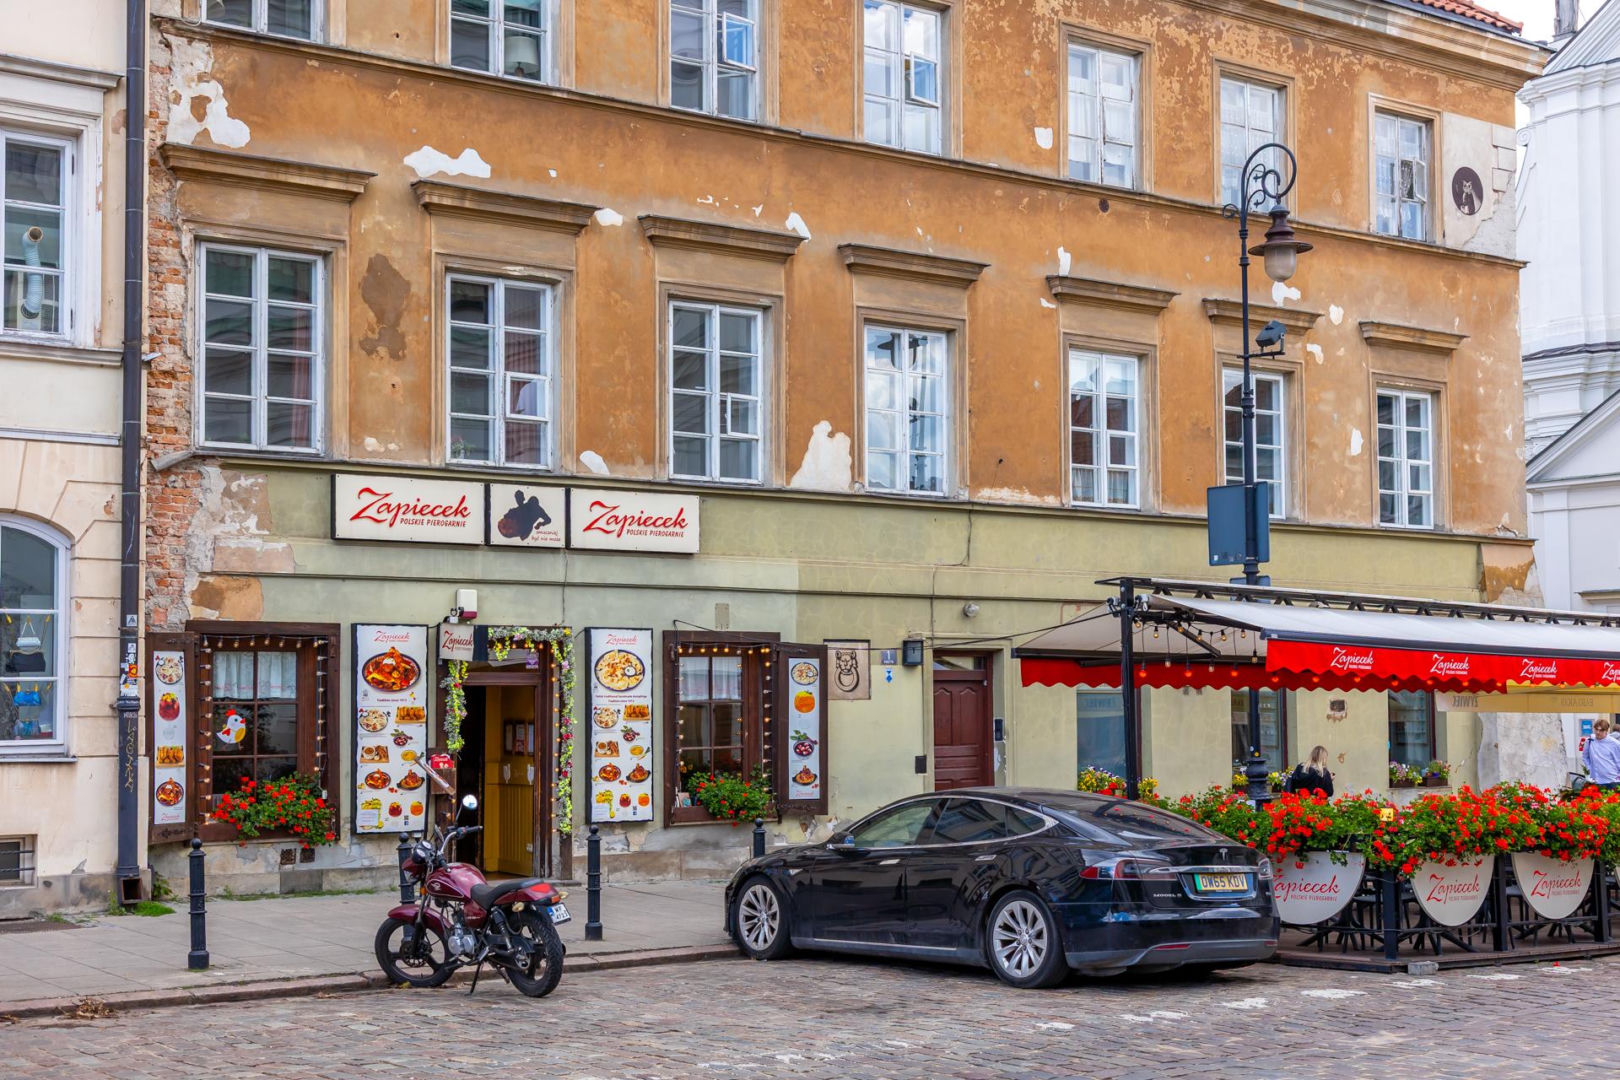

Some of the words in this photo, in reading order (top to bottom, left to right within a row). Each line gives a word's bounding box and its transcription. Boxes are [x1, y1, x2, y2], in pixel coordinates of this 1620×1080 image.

[349, 487, 471, 528] Zapiecek
[582, 500, 689, 538] Zapiecek
[400, 518, 425, 526] POLSKIE
[426, 519, 467, 527] PIEROGARNIE
[626, 529, 648, 537] POLSKIE
[649, 530, 685, 538] PIEROGARNIE
[374, 631, 411, 643] Zapiecek
[442, 630, 473, 652] Zapiecek
[1330, 647, 1374, 670] Zapiecek
[1430, 653, 1470, 676] Zapiecek
[1520, 658, 1558, 679] Zapiecek
[1228, 875, 1246, 888] KDV
[1273, 874, 1340, 902] apiecek
[1426, 873, 1480, 904] Zapiecek
[1531, 869, 1581, 899] Zapiecek
